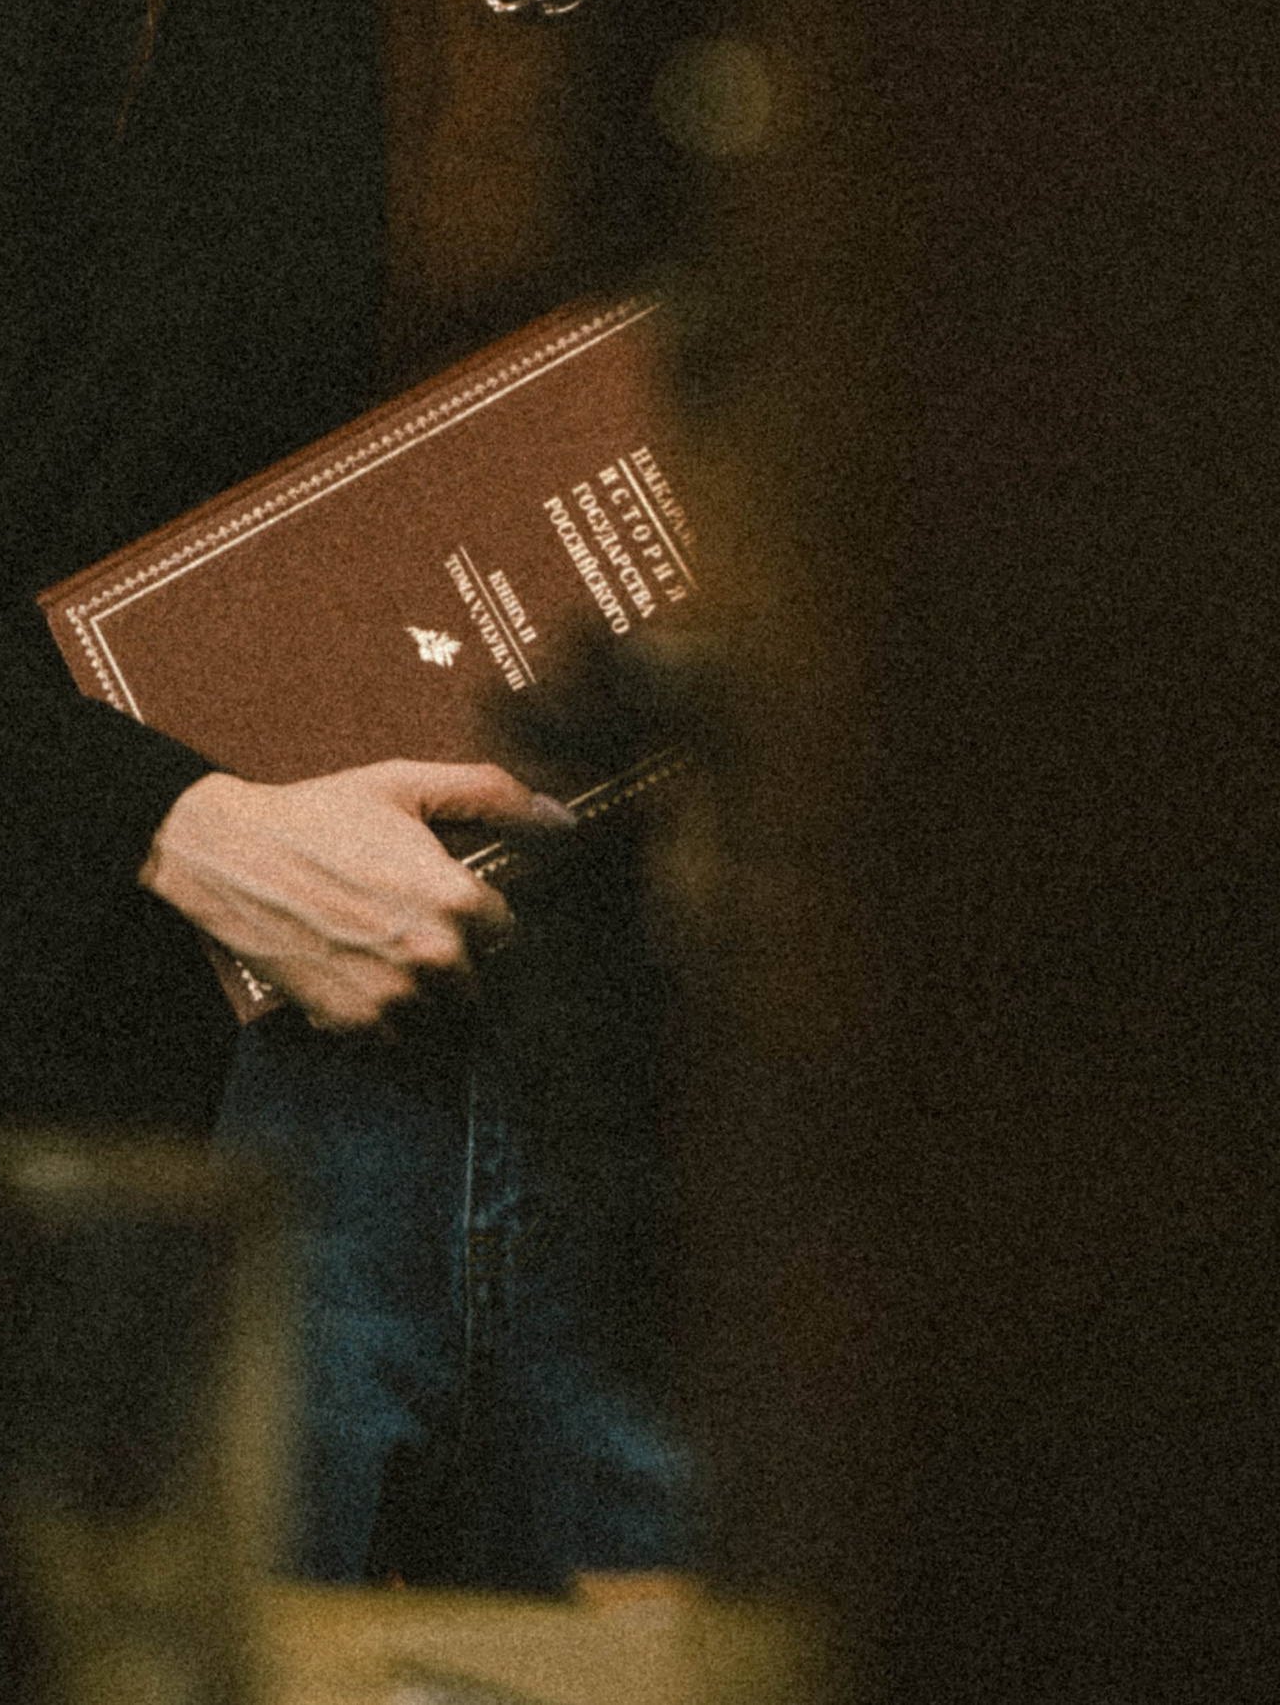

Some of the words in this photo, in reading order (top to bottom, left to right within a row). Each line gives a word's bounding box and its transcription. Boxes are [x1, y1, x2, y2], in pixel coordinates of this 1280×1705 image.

[444, 553, 476, 604] ТОМА
[488, 569, 526, 629] КНИГА
[543, 496, 631, 635] РОССИЙСКОГО
[572, 482, 657, 619] ГОСУДАРСТВА
[597, 466, 687, 603] ИСТОРИЯ
